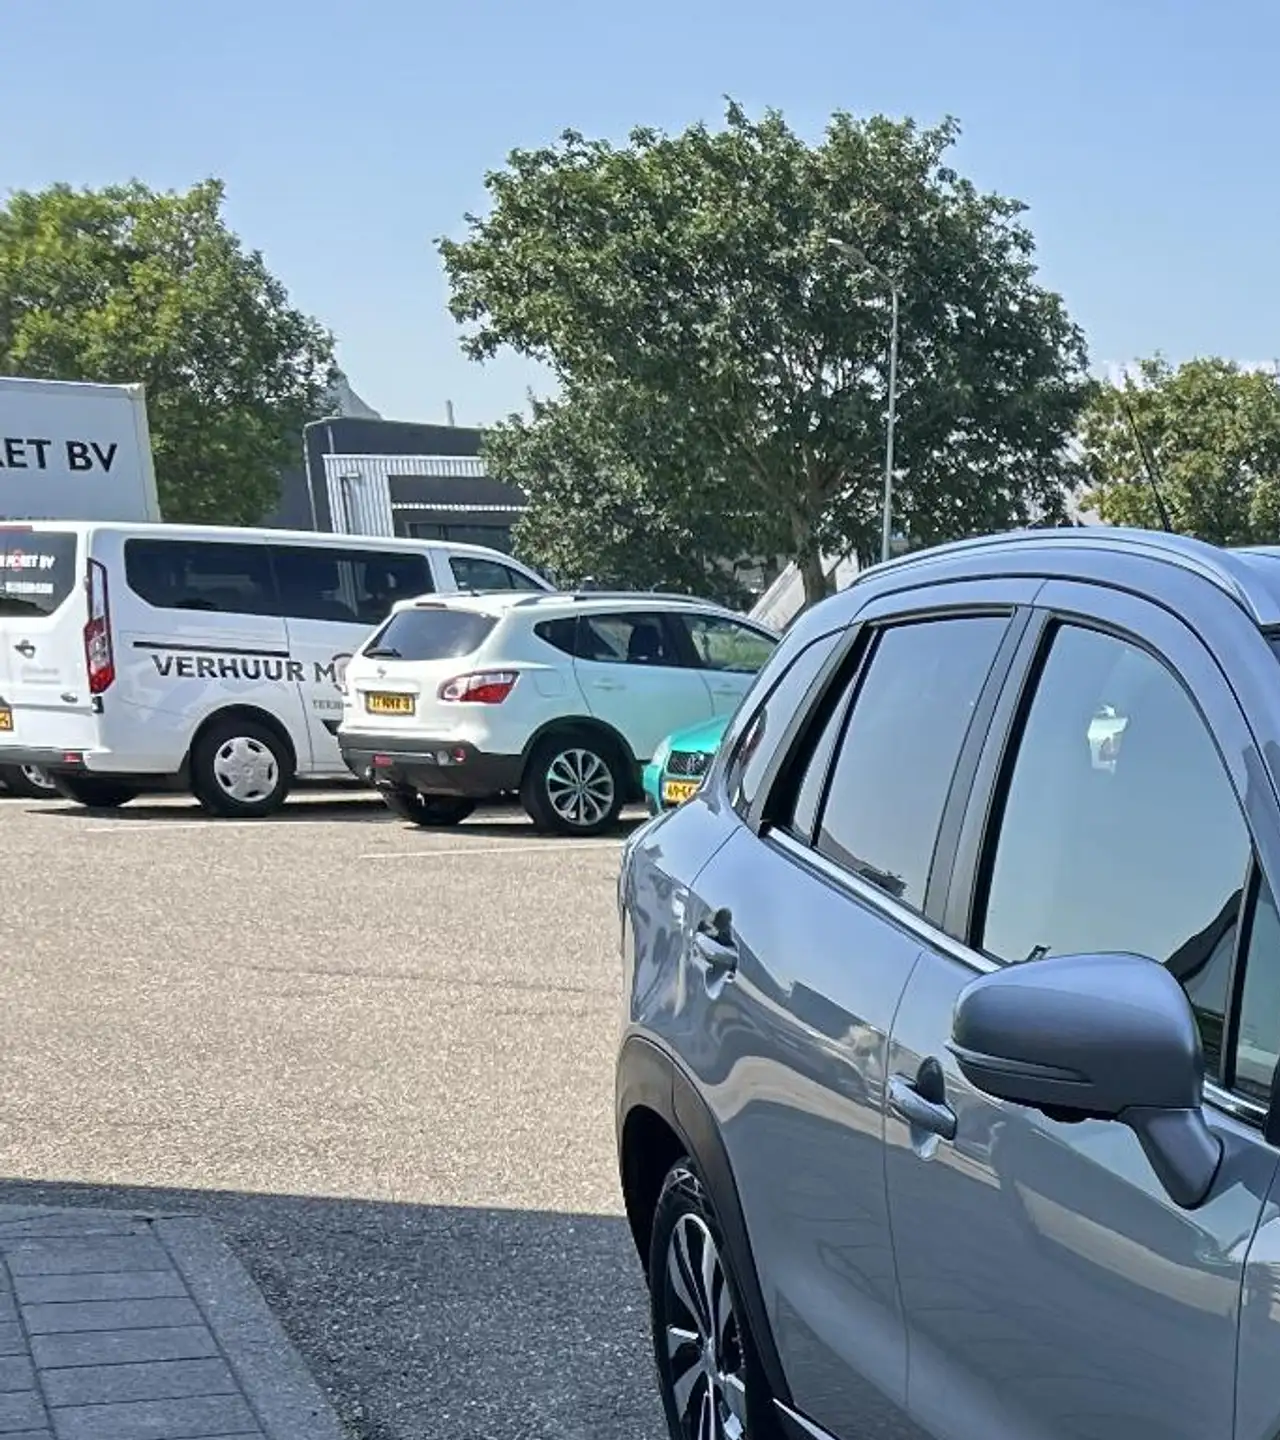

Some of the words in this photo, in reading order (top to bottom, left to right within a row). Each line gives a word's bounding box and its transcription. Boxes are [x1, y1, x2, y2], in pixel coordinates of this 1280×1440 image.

[0, 438, 52, 470] ET
[66, 441, 117, 473] BV
[152, 654, 306, 682] VERHUUR
